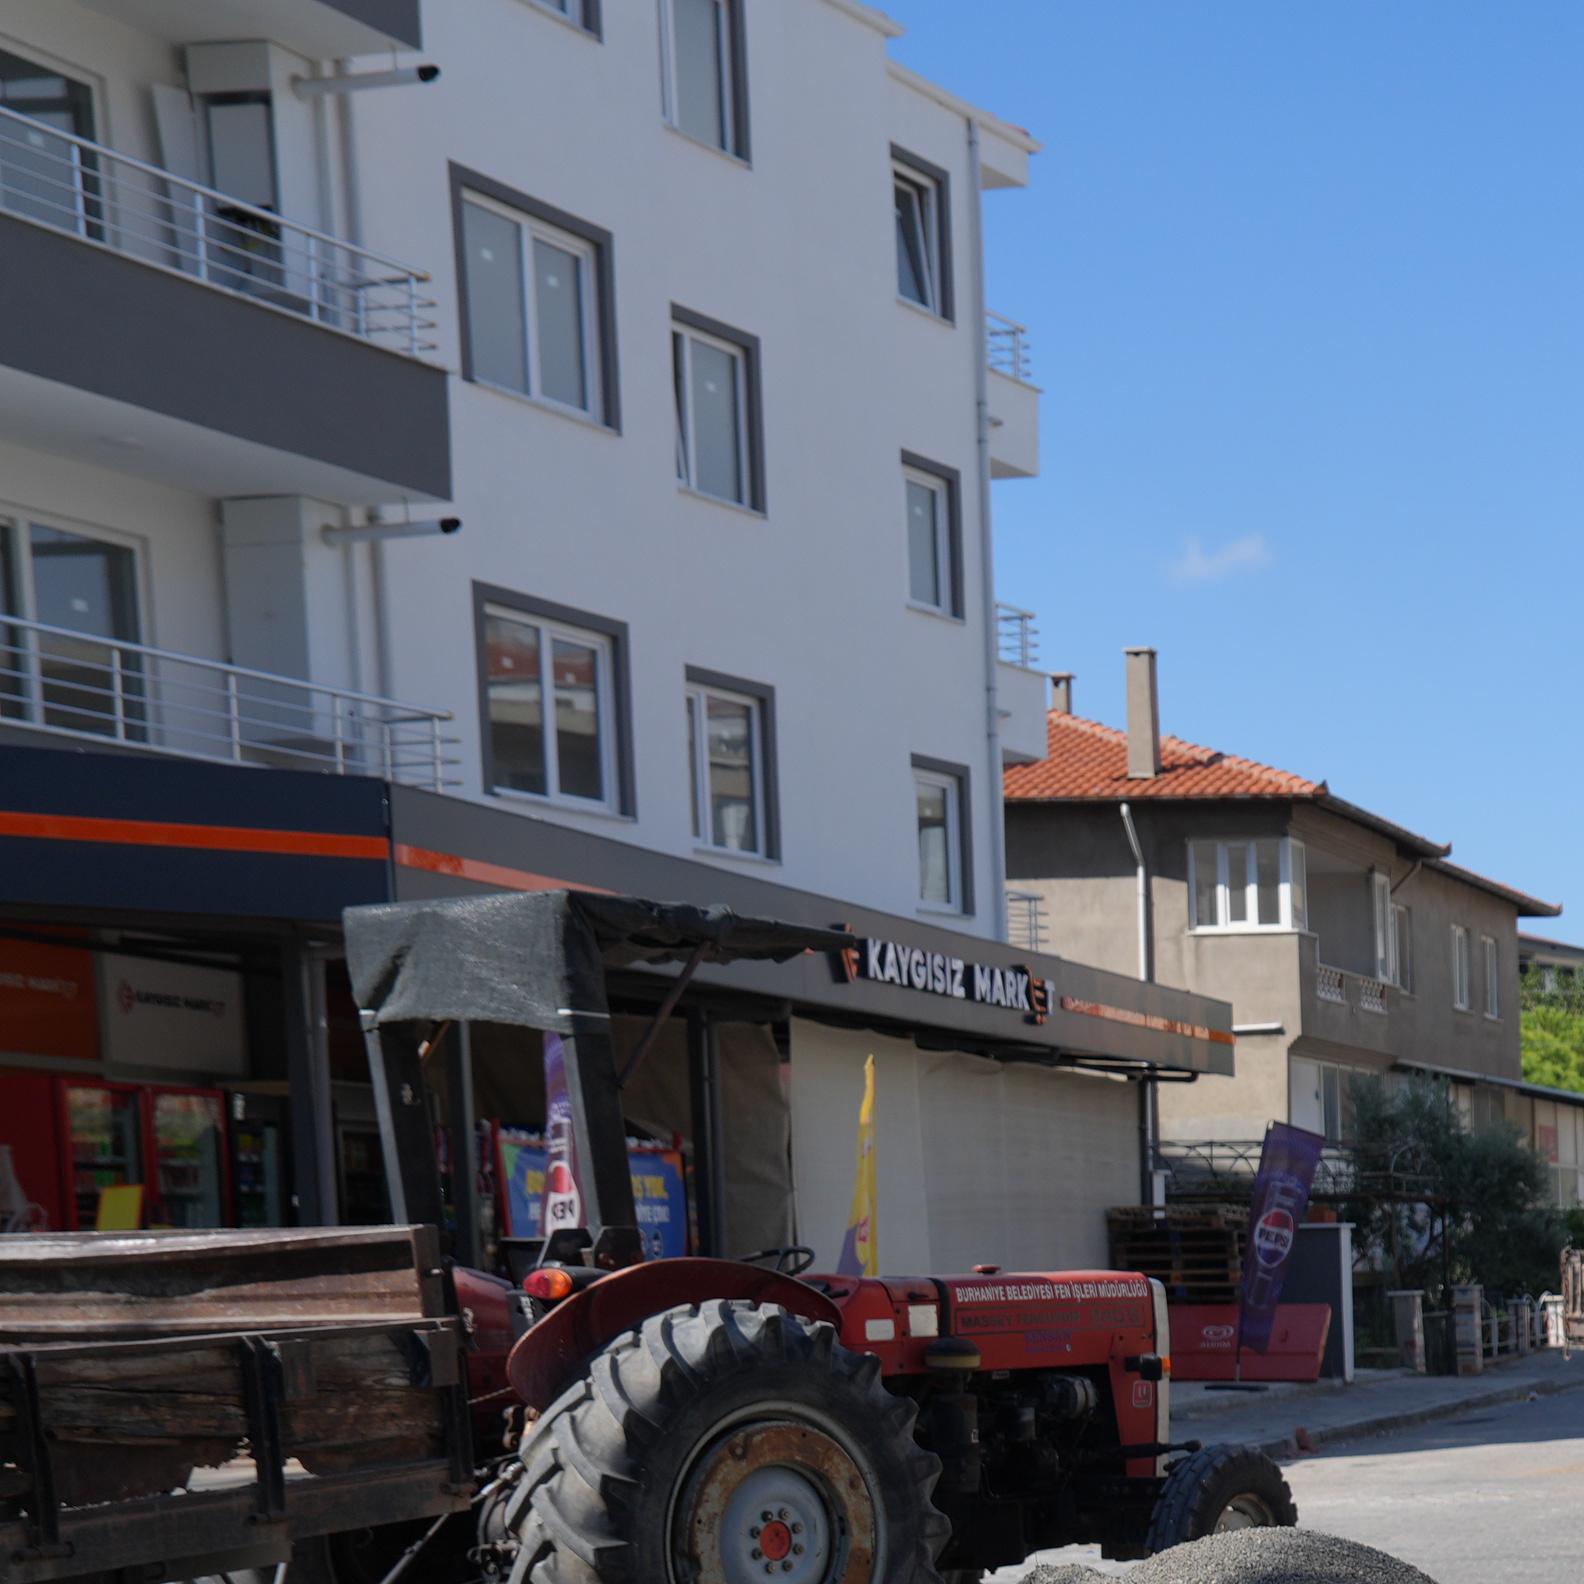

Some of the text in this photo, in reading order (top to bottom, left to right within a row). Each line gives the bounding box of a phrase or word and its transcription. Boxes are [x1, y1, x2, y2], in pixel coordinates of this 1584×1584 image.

[867, 938, 966, 998] KAYGISIZ
[974, 963, 1055, 1022] MARKET
[1258, 1228, 1290, 1248] PEPSI
[955, 1279, 1148, 1303] BURHANİYE BELEDİYESİ FEN İŞLERİ MÜDÜRLÜĞÜ
